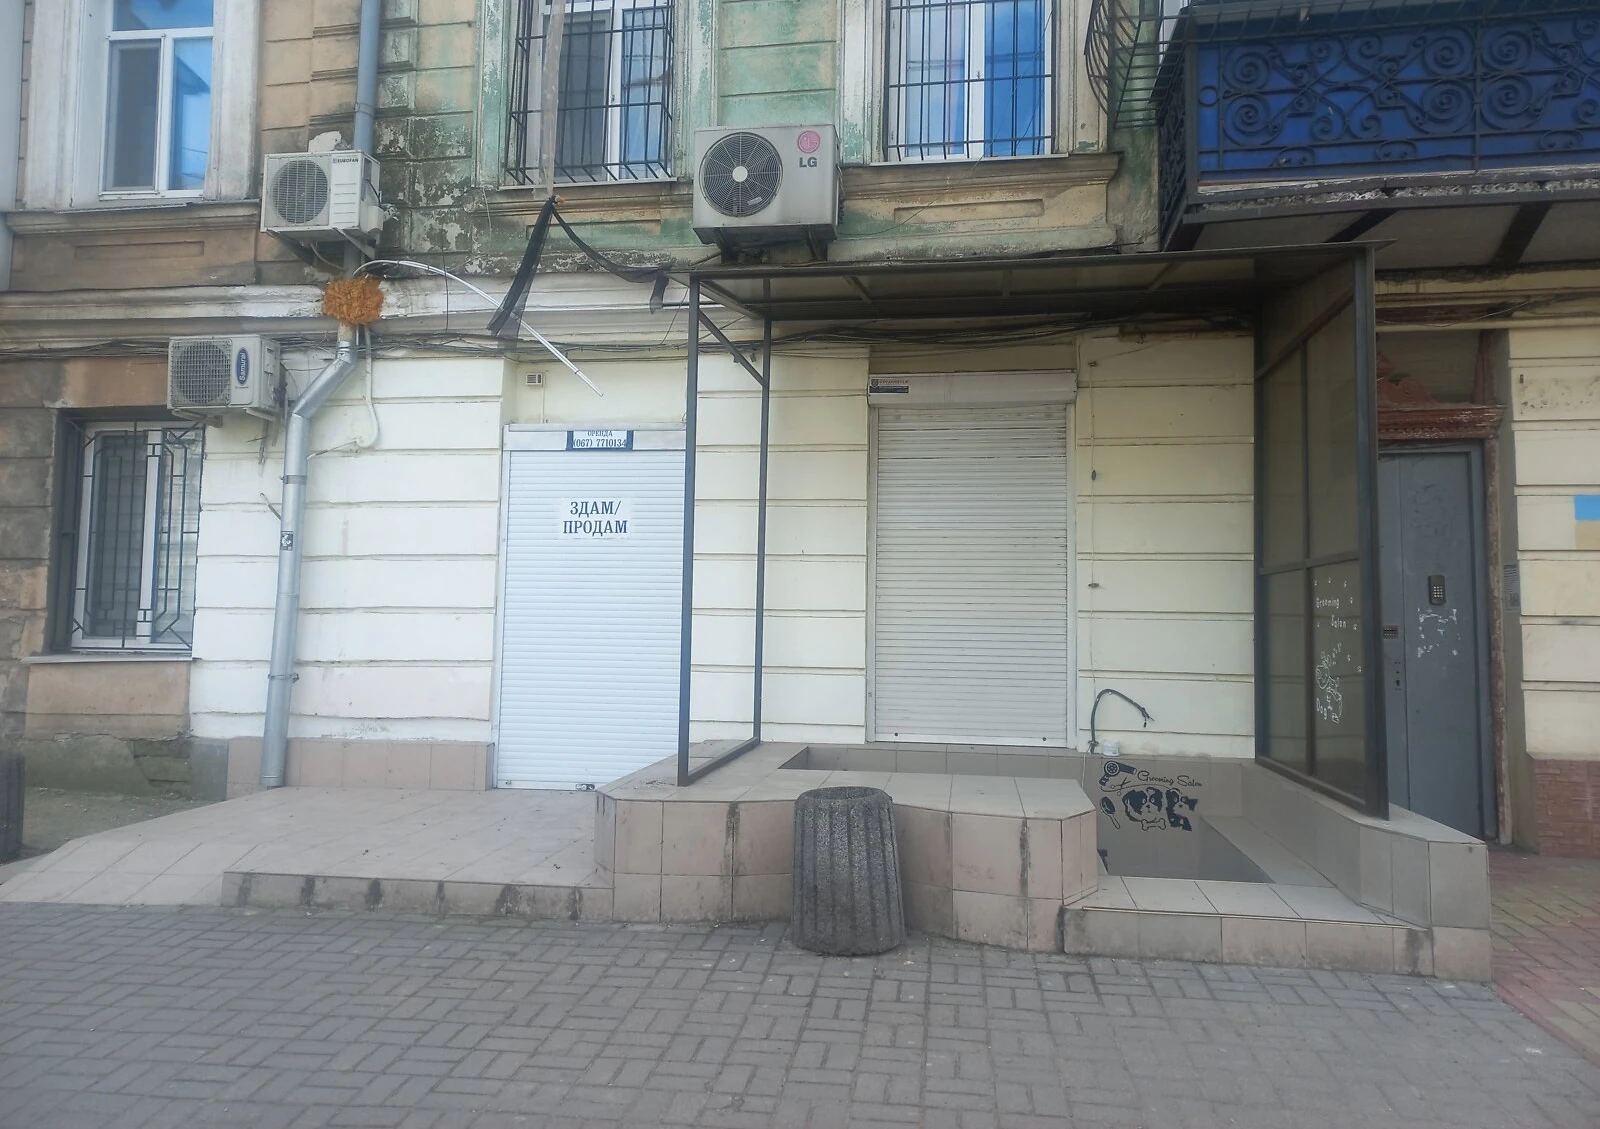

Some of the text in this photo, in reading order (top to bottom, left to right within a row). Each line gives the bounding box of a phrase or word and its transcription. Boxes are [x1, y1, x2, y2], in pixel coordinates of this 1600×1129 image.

[799, 156, 818, 168] LG
[573, 438, 627, 448] (067) 7710134
[570, 500, 622, 518] ЗДАМ/
[563, 520, 628, 537] ПРОДАМ
[1137, 770, 1174, 786] Grooming
